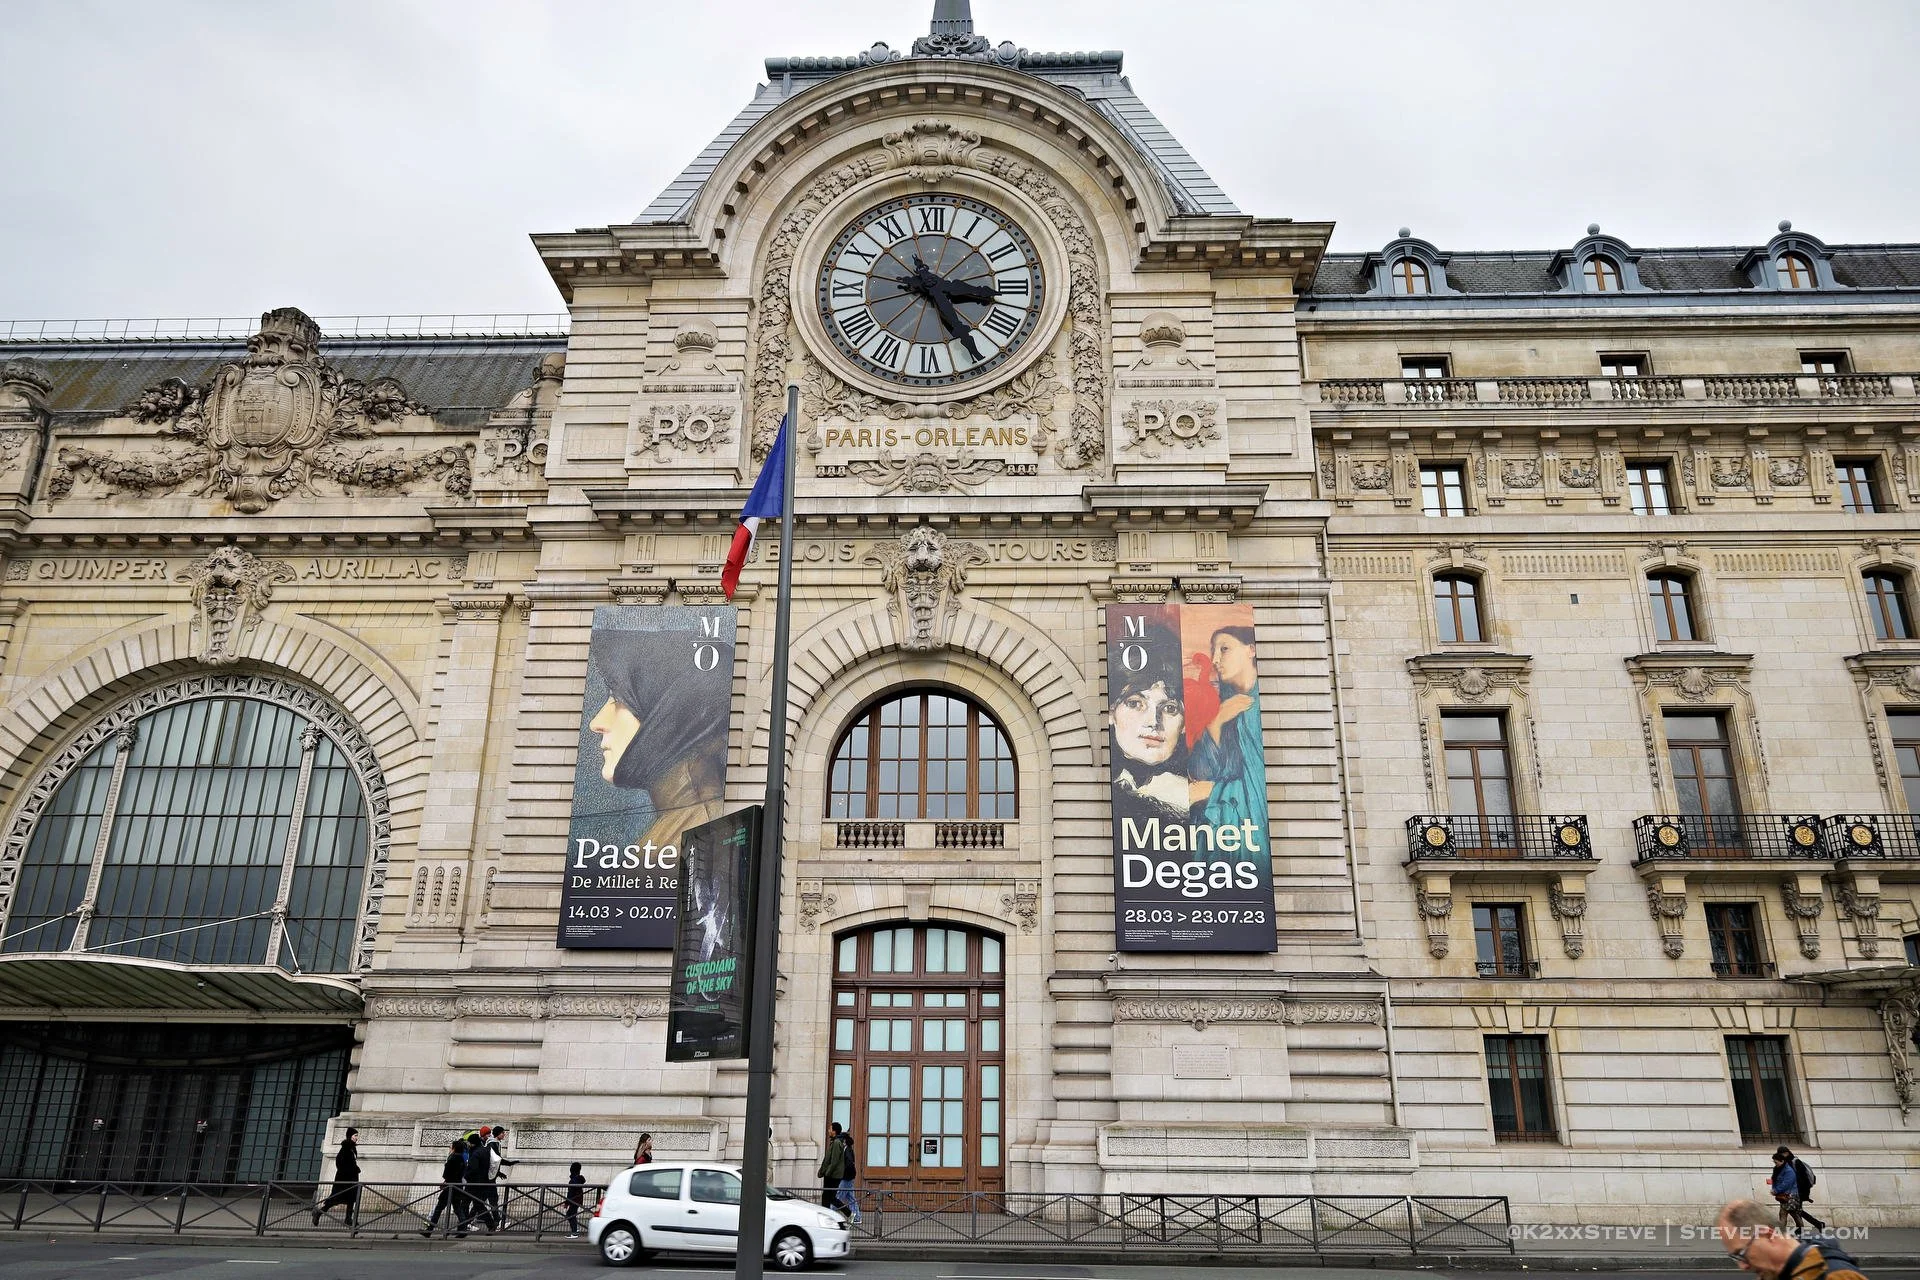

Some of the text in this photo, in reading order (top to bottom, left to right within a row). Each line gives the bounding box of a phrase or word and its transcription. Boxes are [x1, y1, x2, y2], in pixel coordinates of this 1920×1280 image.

[875, 214, 907, 244] XI
[918, 207, 945, 232] XII
[963, 216, 982, 240] I
[844, 242, 877, 266] X
[986, 241, 1018, 263] II
[832, 279, 864, 299] IX
[997, 278, 1029, 297] III
[982, 307, 1021, 339] IIII
[870, 334, 902, 369] VII
[919, 346, 942, 374] VI
[653, 413, 715, 443] PO
[1137, 408, 1203, 438] PO
[826, 427, 1028, 448] PARIS-ORLEANS
[989, 539, 1088, 562] TOURS
[36, 558, 168, 580] QUIMPER
[301, 558, 441, 579] AURILLAC
[698, 616, 721, 638] M
[1122, 615, 1147, 638] M
[1122, 818, 1260, 852] Manet
[573, 838, 678, 870] Paste
[571, 875, 678, 889] De Millet à Re
[1122, 854, 1259, 898] Degas
[568, 905, 611, 919] 14.03
[1124, 909, 1174, 923] 28.03
[1191, 910, 1267, 924] 23.07.23
[685, 957, 737, 979] CUSTODIANS
[686, 975, 734, 995] OF THE SKY
